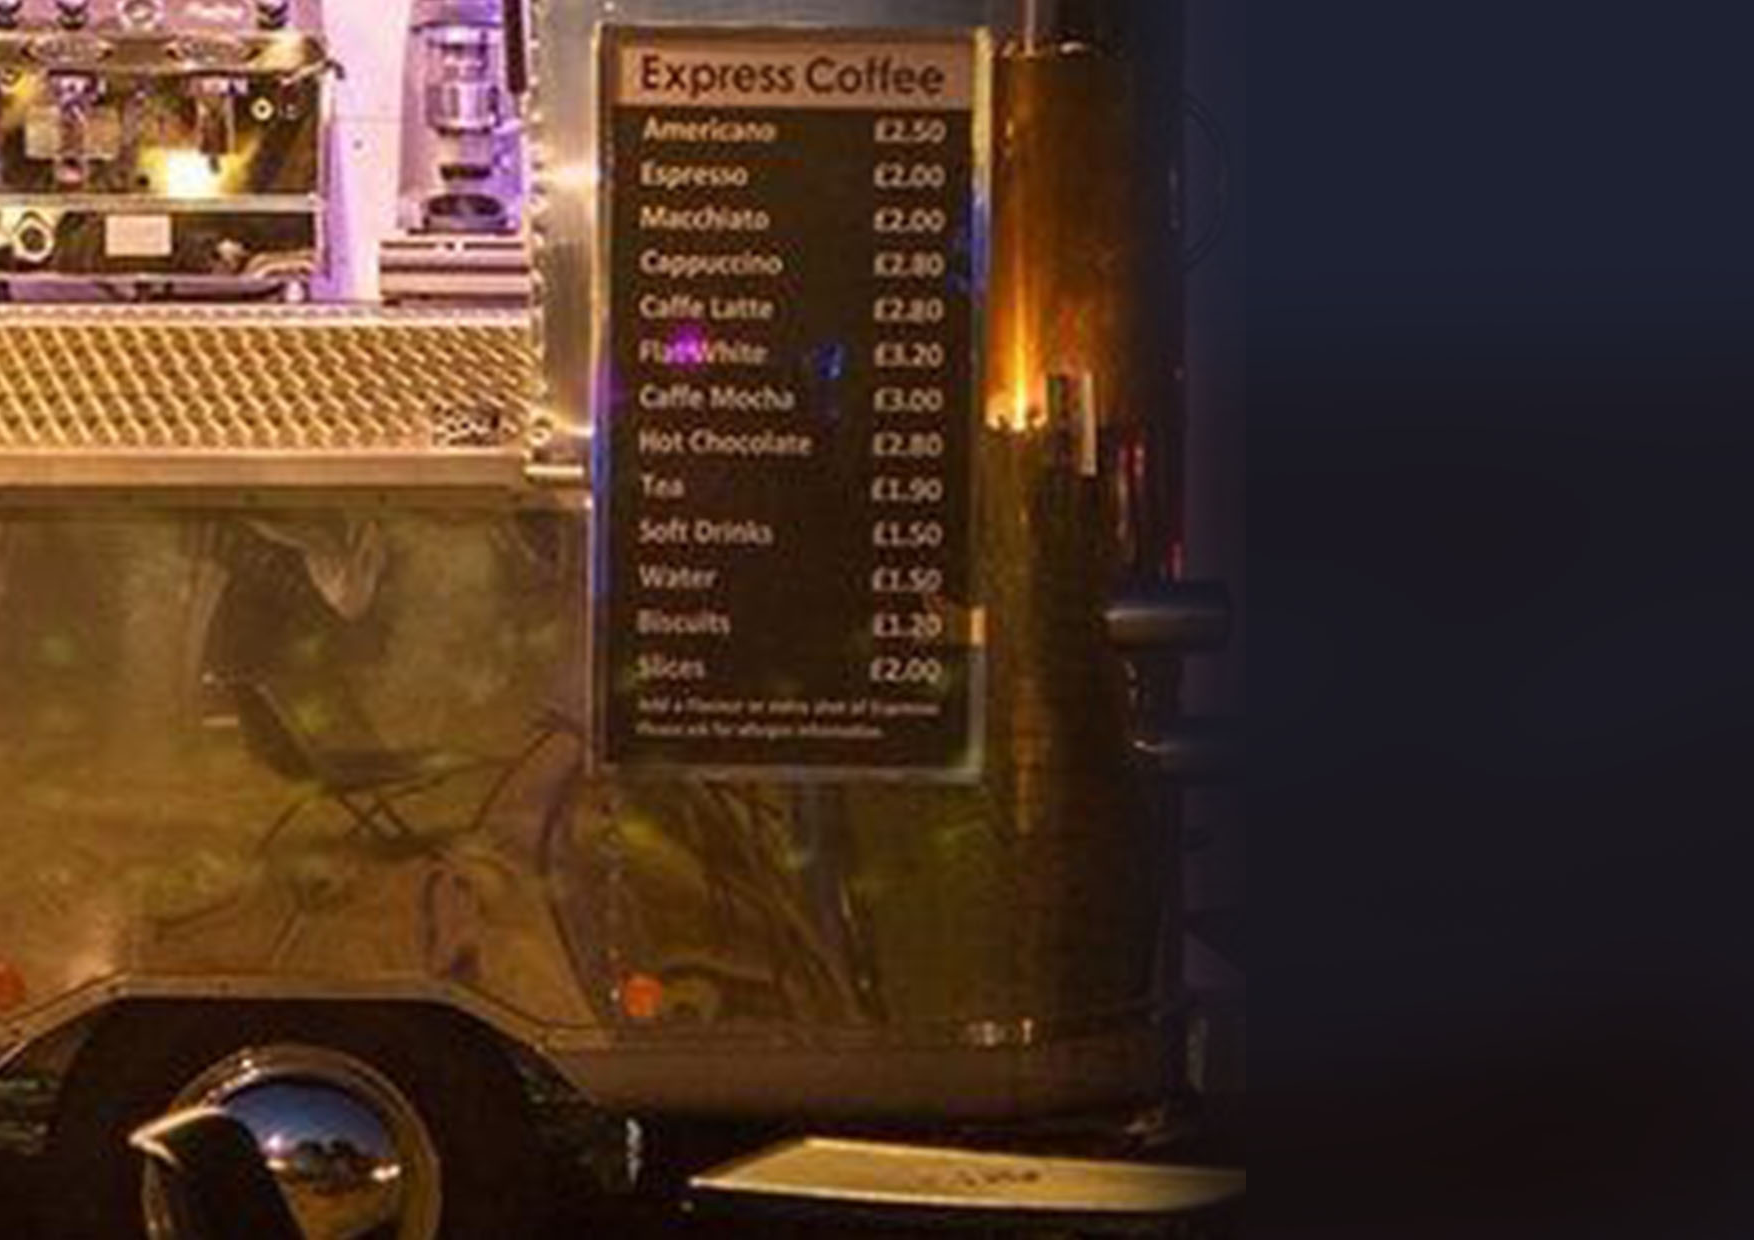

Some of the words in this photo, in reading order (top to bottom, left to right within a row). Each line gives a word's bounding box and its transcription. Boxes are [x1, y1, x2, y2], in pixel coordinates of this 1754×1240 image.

[639, 55, 795, 98] Express
[804, 55, 946, 95] Coffee
[642, 117, 777, 143] Americano
[873, 119, 946, 143] £2.50
[640, 163, 748, 190] Espresso
[873, 164, 945, 187] £2.00
[640, 207, 770, 231] Macchiato
[873, 208, 945, 232] £2.00
[639, 250, 783, 278] Cappuccino
[873, 253, 944, 276] £2.80
[639, 294, 704, 319] Caffe
[710, 296, 774, 320] Latte
[873, 298, 943, 322] £2.80
[687, 339, 768, 365] White
[873, 343, 943, 366] £3.20
[710, 385, 795, 410] Mocha
[873, 388, 943, 411] £3.00
[638, 432, 683, 454] Hot
[688, 429, 812, 456] Chocolate
[872, 433, 943, 456] £2.80
[641, 474, 685, 498] Tea
[870, 477, 943, 501] £1.90
[638, 520, 688, 544] Soft
[693, 520, 773, 545] Drinks
[872, 522, 943, 546] £1.50
[638, 565, 718, 589] Water
[871, 566, 942, 591] £1.50
[637, 609, 731, 634] Biscuits
[872, 612, 943, 637] £1.20
[637, 654, 706, 680] Slices
[870, 658, 942, 683] £2.00
